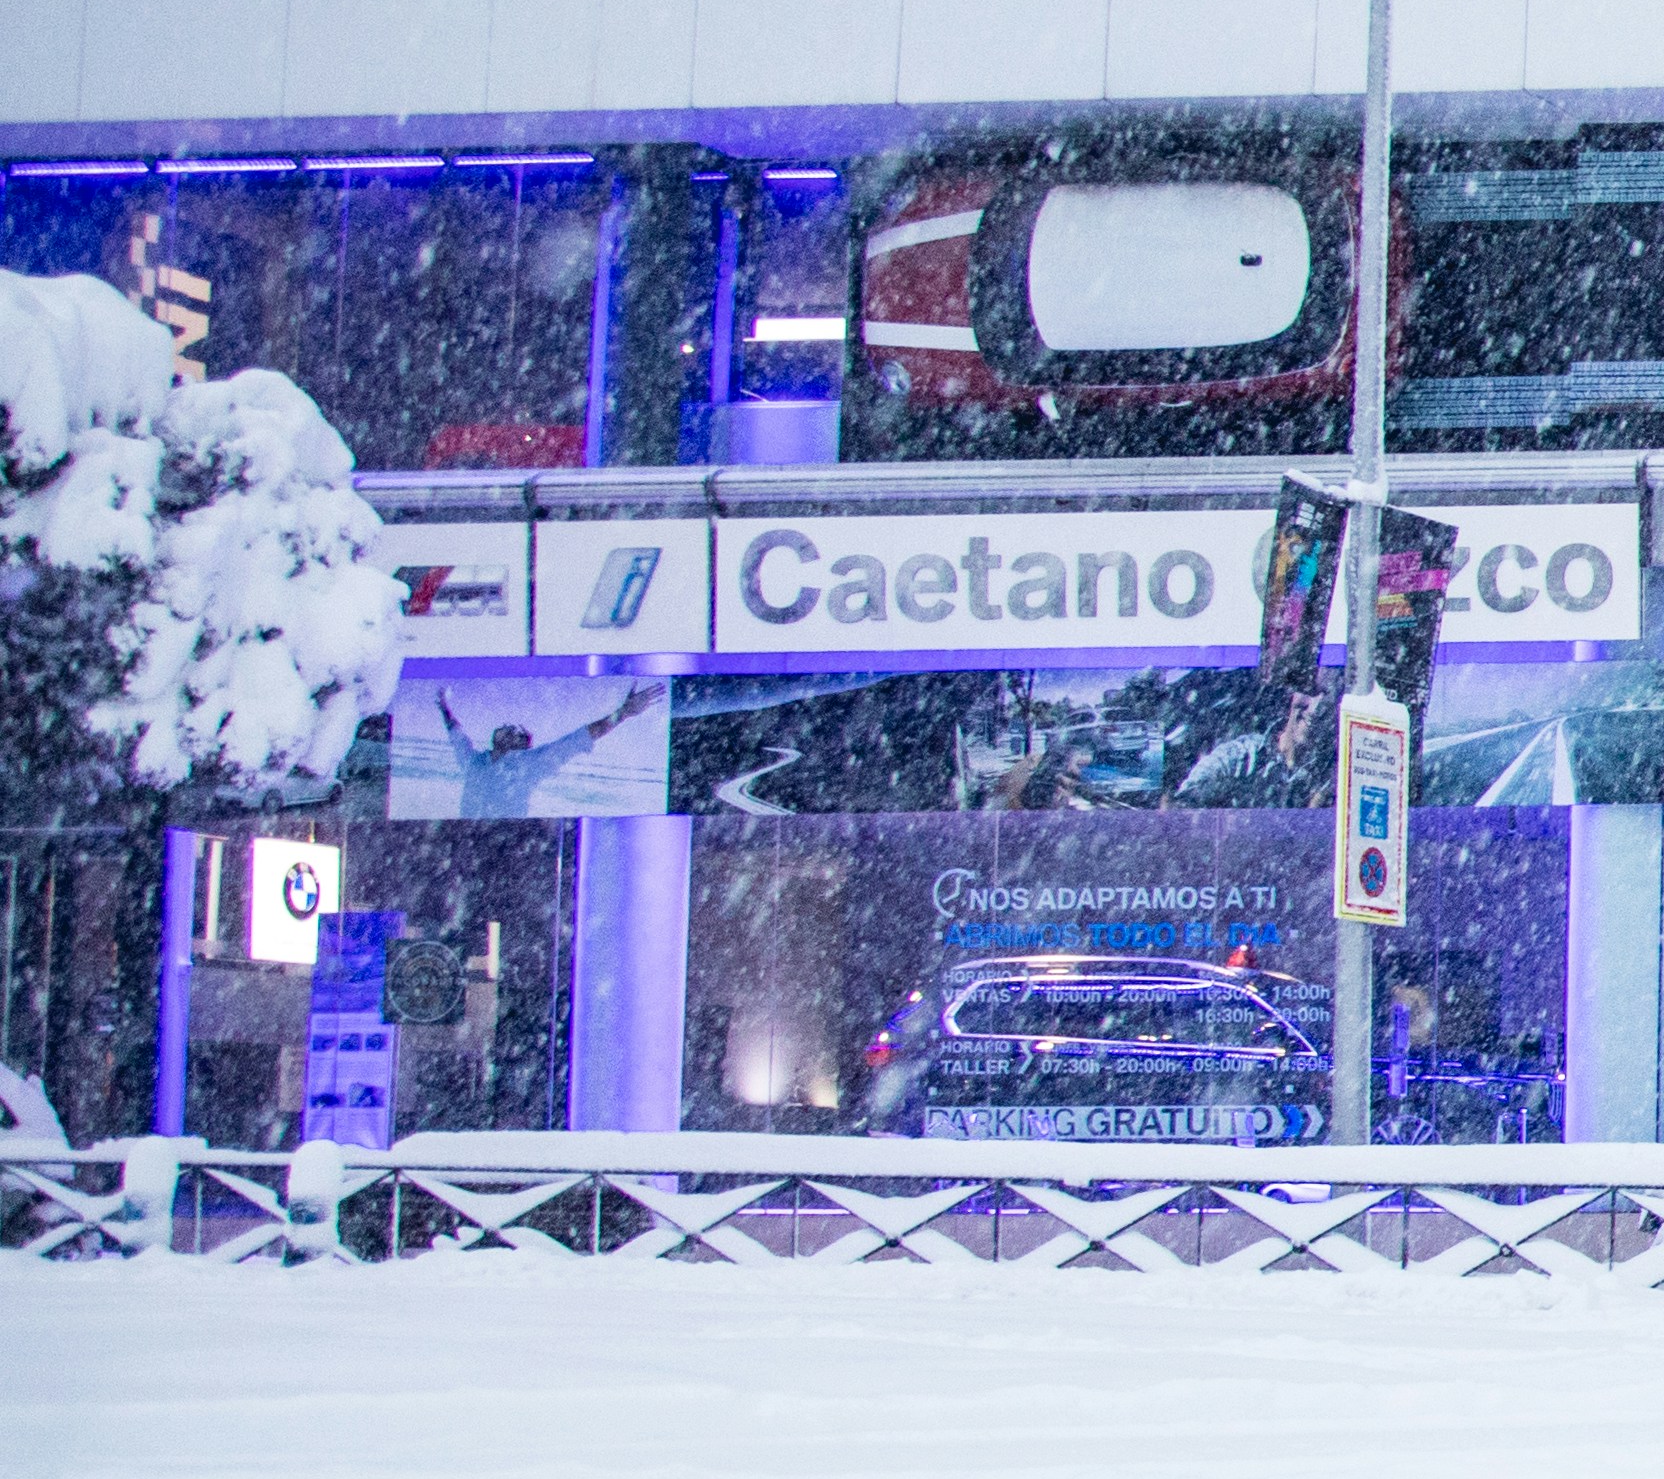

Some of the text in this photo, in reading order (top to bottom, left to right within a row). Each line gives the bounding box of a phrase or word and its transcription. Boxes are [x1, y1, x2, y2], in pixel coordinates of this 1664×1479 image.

[739, 528, 1216, 625] Caetano
[970, 888, 1030, 911] NOS
[1036, 886, 1217, 910] ADAPTAMOS
[1225, 886, 1244, 909] A
[946, 922, 1080, 948] ABRIMOS
[1088, 922, 1176, 949] TODO
[1184, 922, 1220, 947] EL
[943, 989, 1011, 1003] VENTAS
[1273, 985, 1330, 1000] 14:00h
[941, 1041, 1011, 1053] HORARIO
[943, 1060, 1010, 1074] TALLER
[1041, 1059, 1100, 1073] 07:30h
[1118, 1058, 1176, 1073] 20:00h
[928, 1107, 1273, 1137] PARKING GRATUITO
